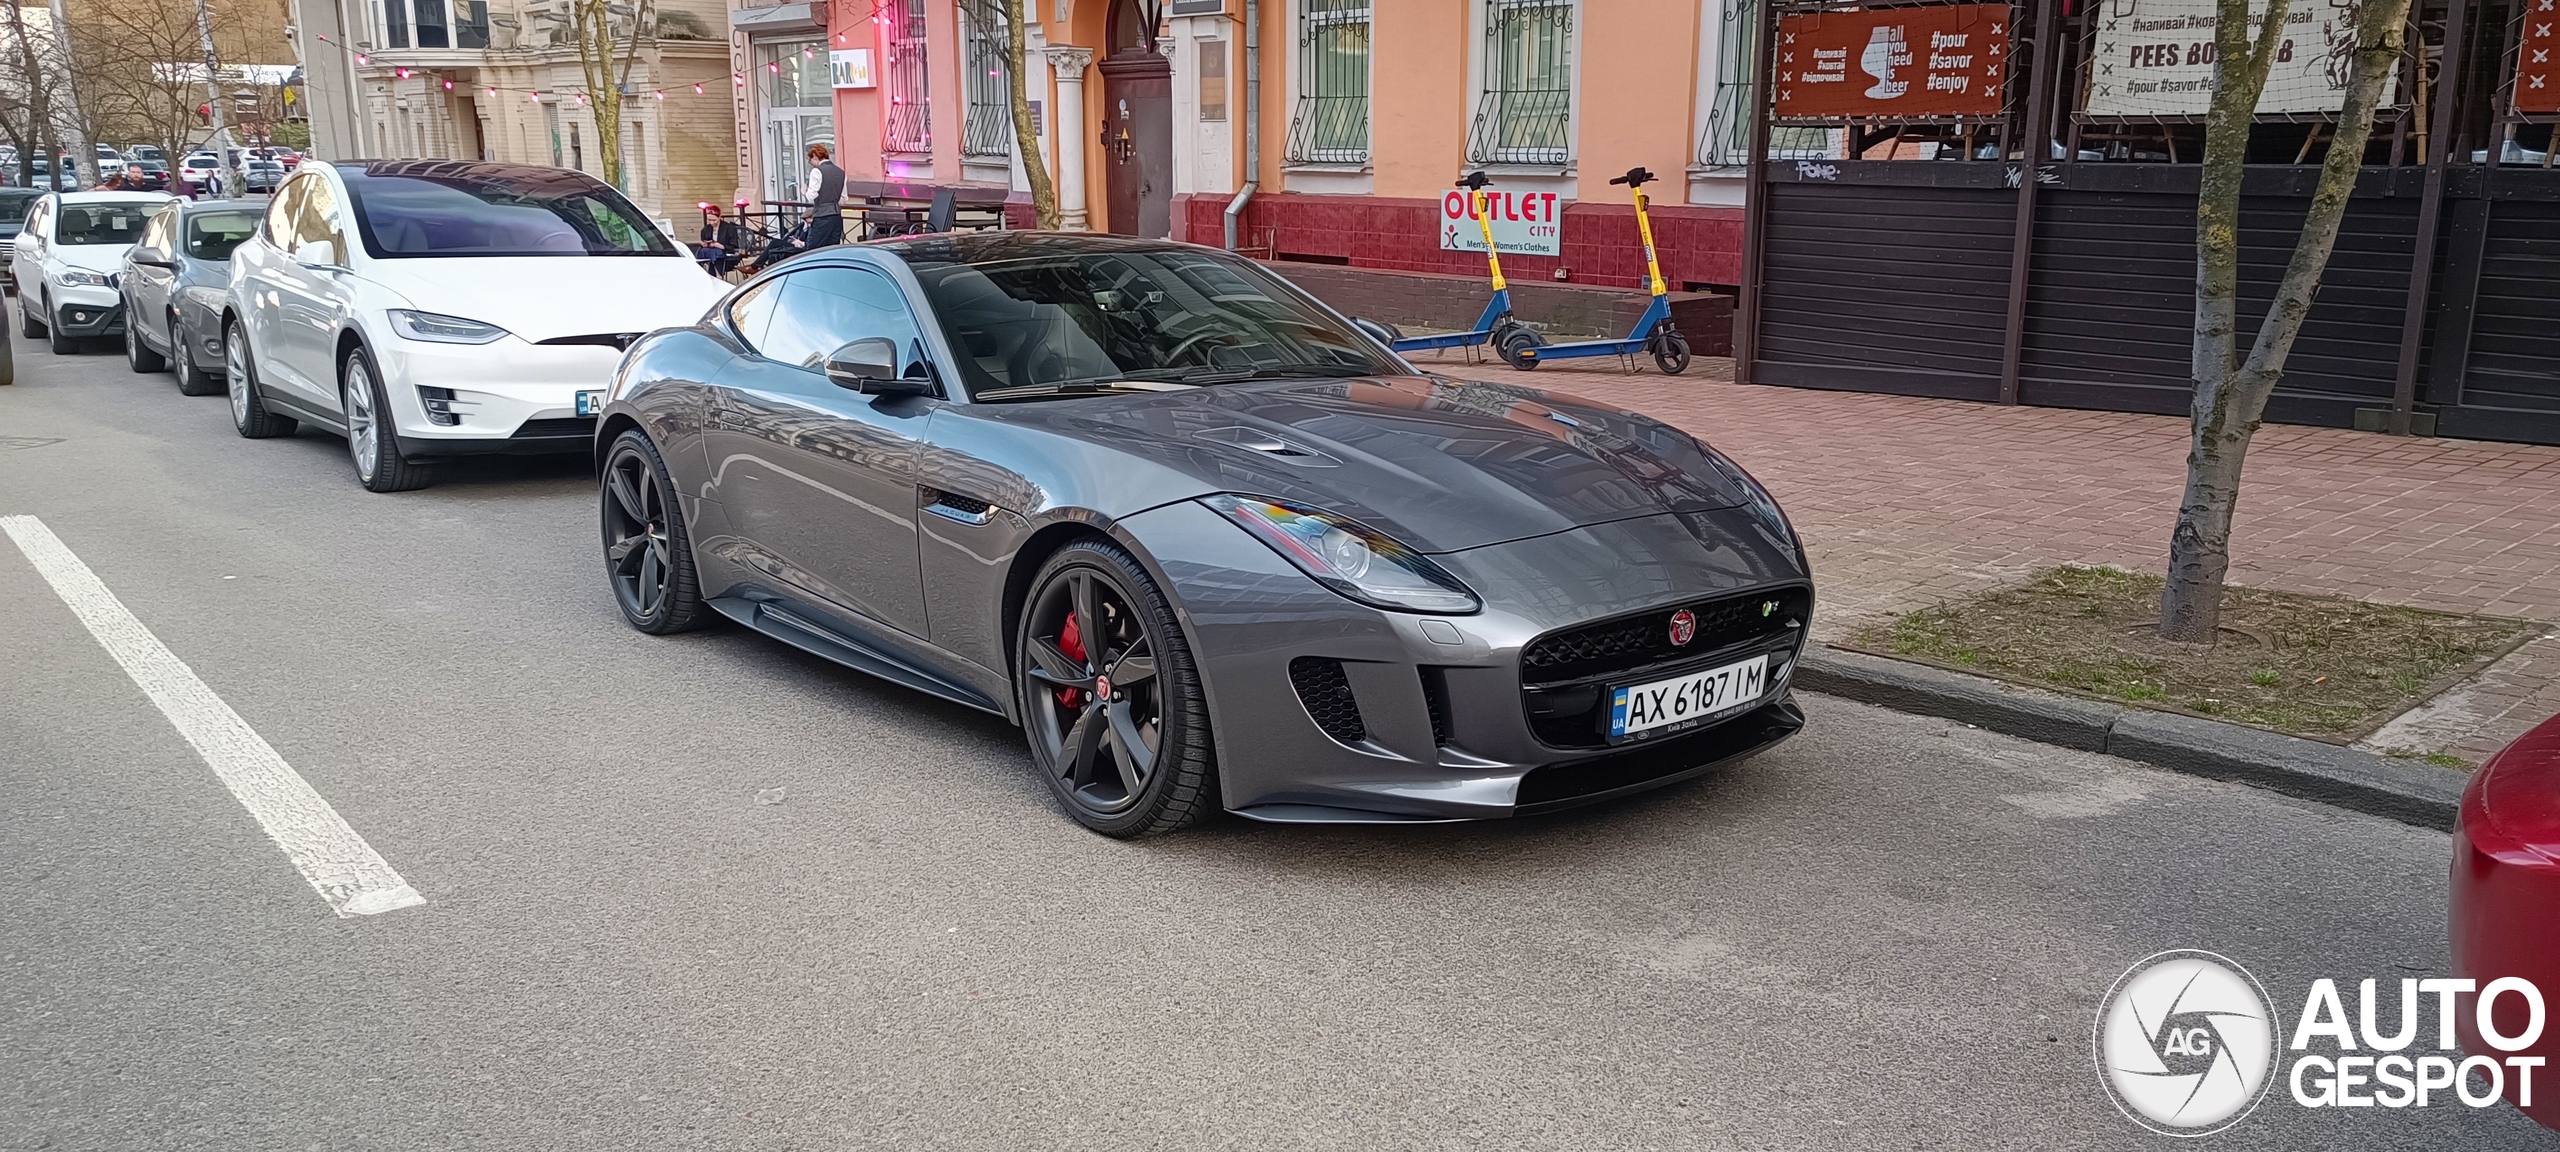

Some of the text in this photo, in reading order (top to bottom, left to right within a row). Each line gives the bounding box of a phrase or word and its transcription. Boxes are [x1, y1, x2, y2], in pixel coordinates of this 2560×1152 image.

[2132, 15, 2184, 32] #наливай
[1889, 25, 1904, 41] all
[1931, 30, 1969, 52] #pour
[1888, 41, 1907, 55] you
[2129, 44, 2180, 68] PEES
[1887, 52, 1913, 66] need
[1928, 51, 1973, 70] #savor
[1886, 65, 1896, 79] is
[1885, 79, 1909, 93] beer
[1926, 72, 1970, 94] #enjoy
[2126, 78, 2159, 96] #pour
[2160, 77, 2198, 93] #savor
[1444, 191, 1557, 223] OUTLET
[1529, 225, 1556, 238] CITY
[1523, 242, 1550, 253] Clothes
[939, 507, 972, 519] JAGUAR
[1628, 661, 1763, 727] AX 6187 IM
[1612, 718, 1625, 730] UA
